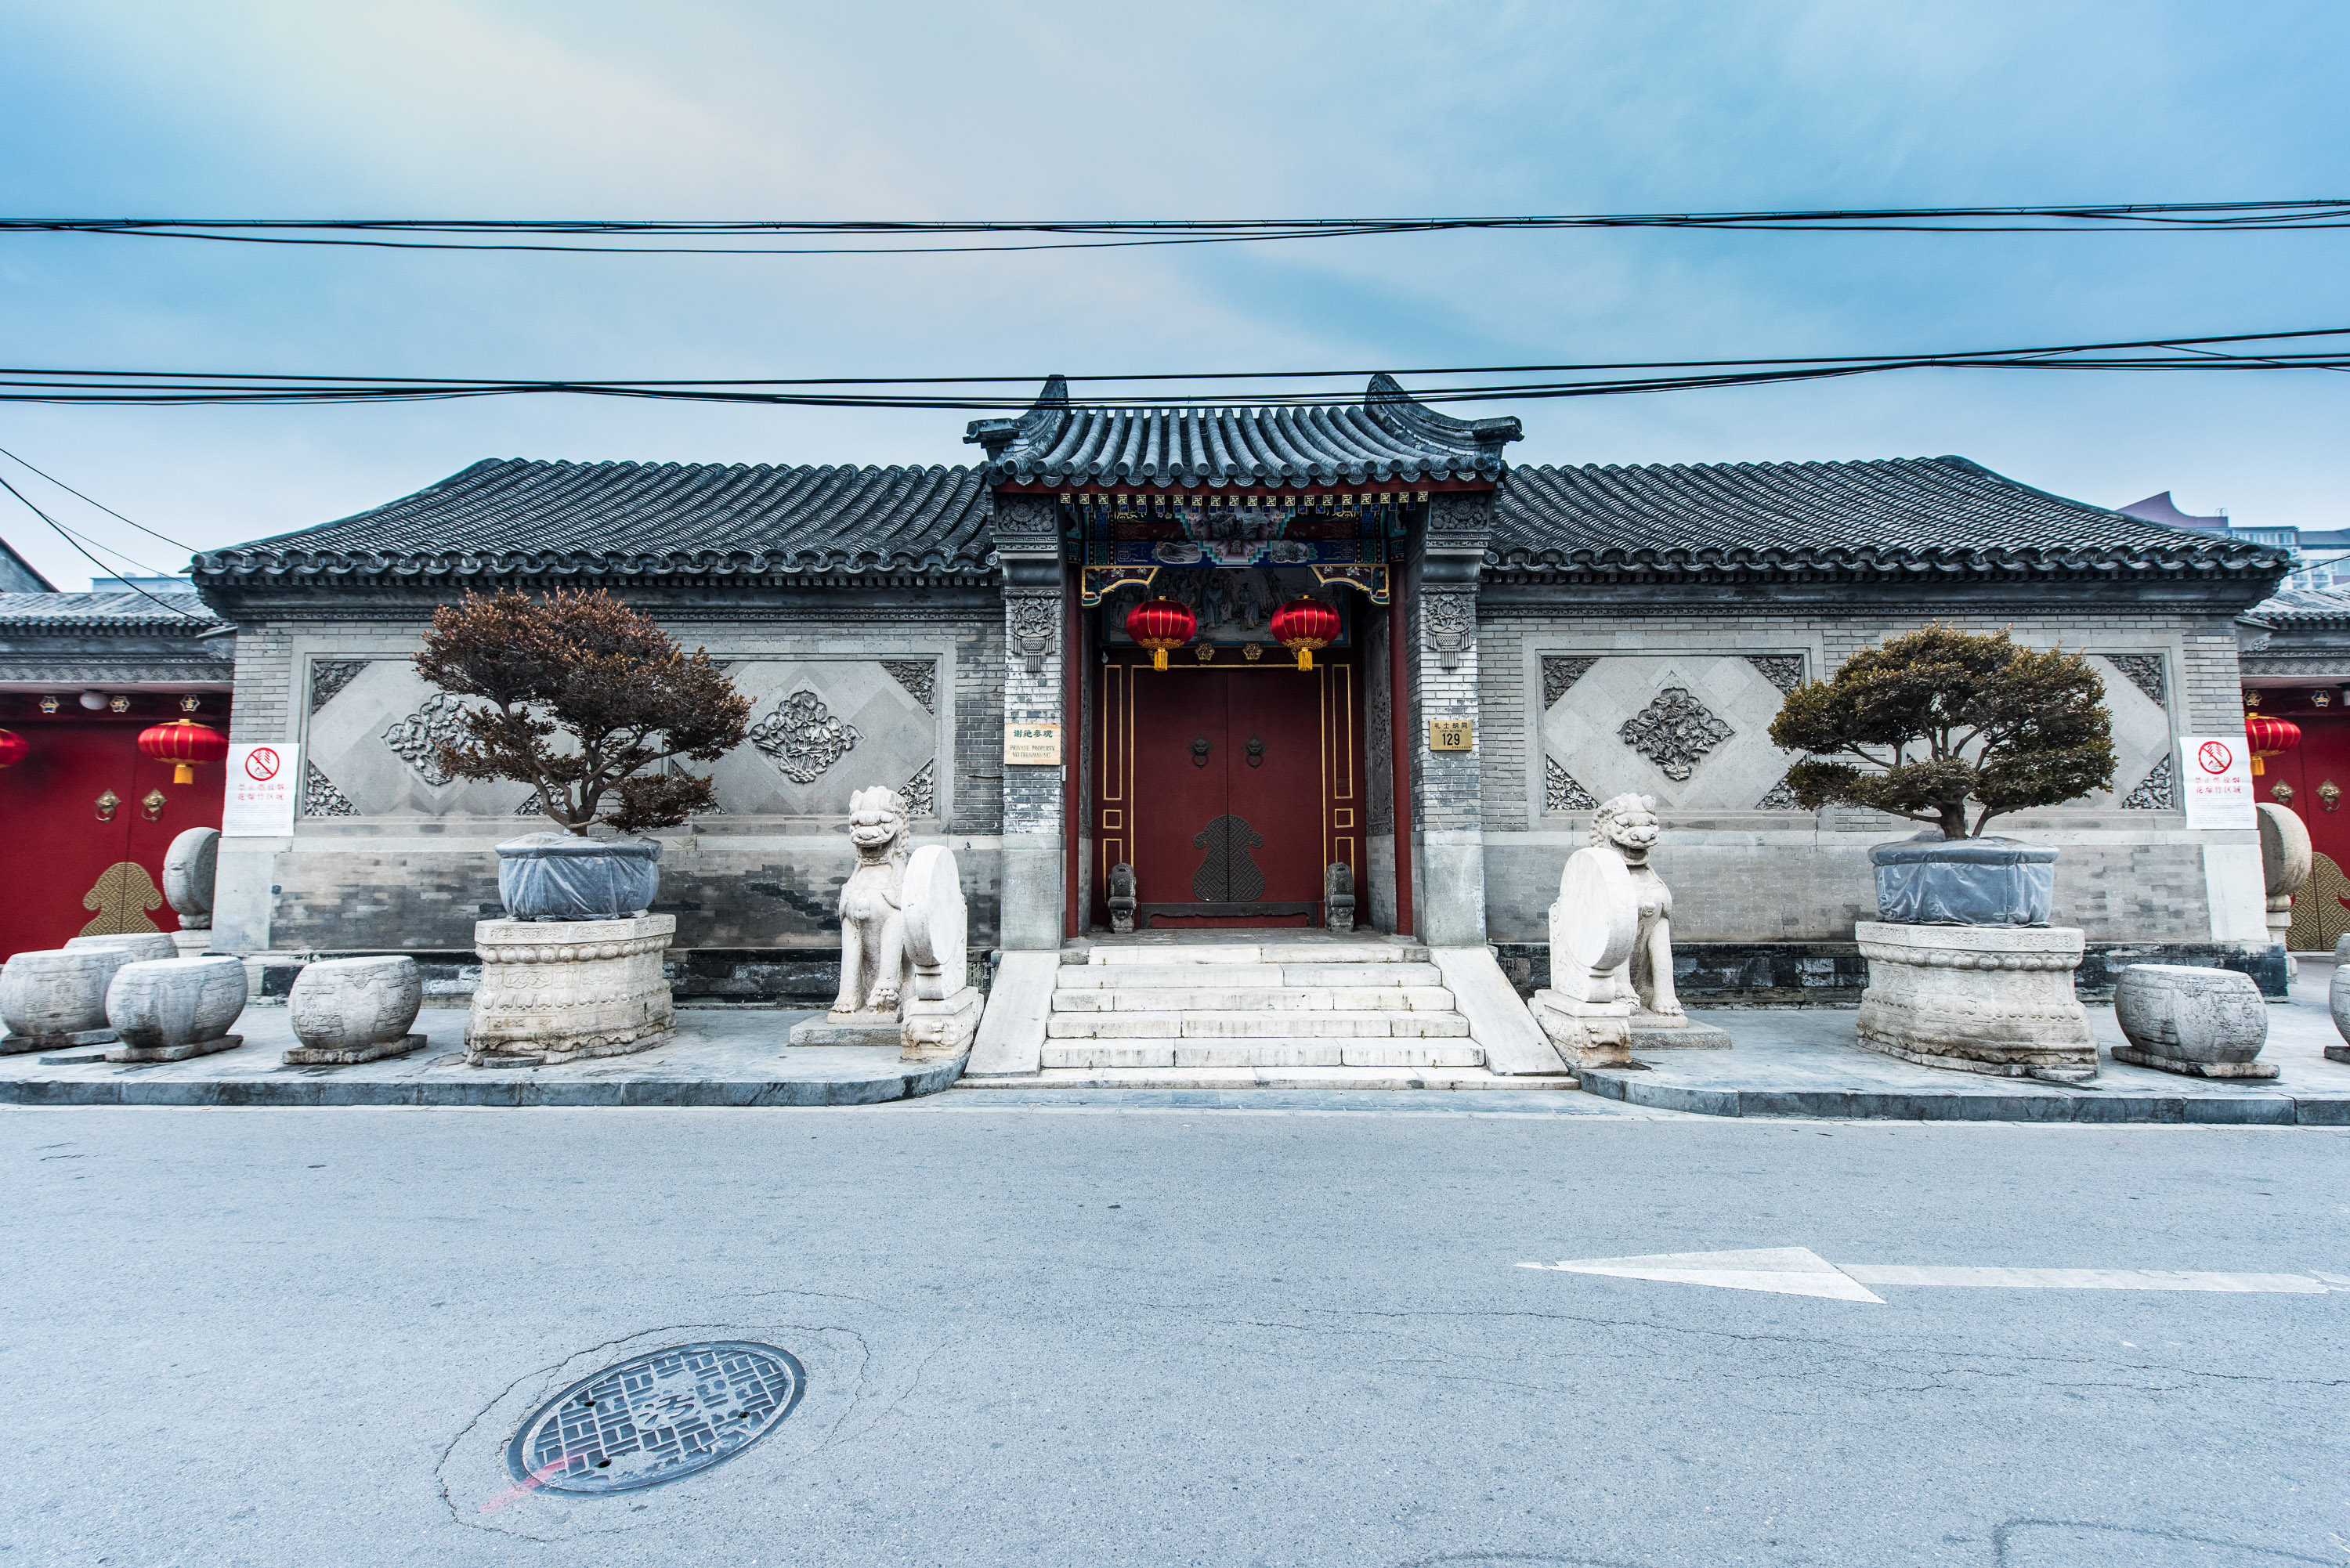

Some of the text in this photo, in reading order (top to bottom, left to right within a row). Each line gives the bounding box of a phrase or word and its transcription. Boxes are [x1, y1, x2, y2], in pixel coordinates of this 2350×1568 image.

[1014, 729, 1053, 738] 谢绝参观
[1442, 733, 1460, 746] 129
